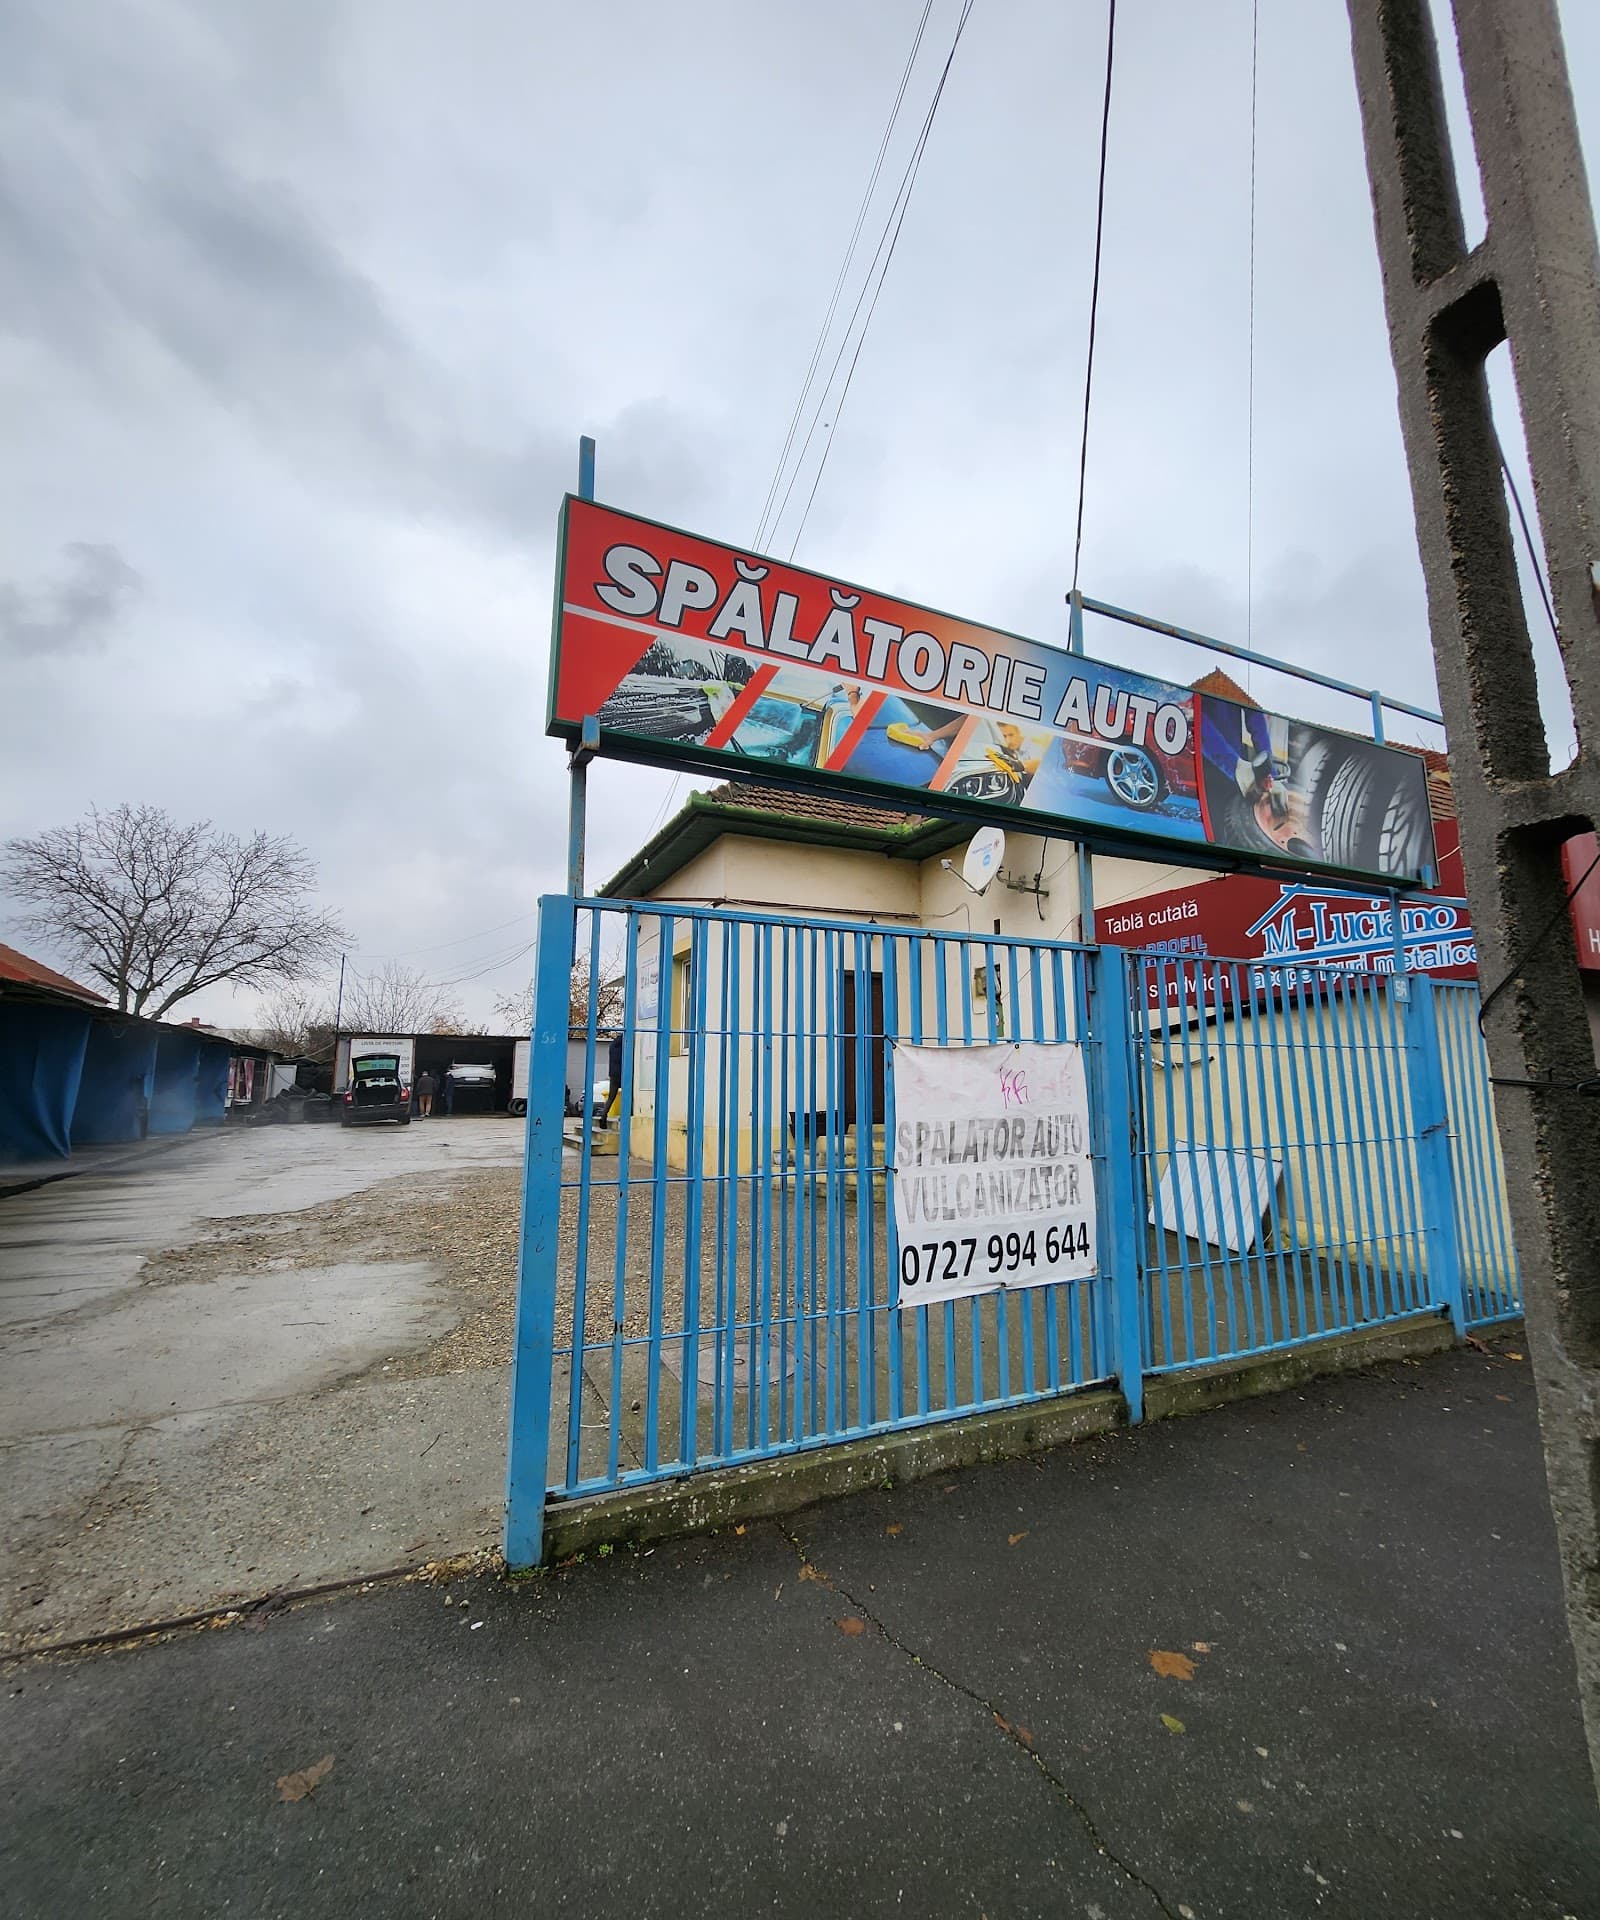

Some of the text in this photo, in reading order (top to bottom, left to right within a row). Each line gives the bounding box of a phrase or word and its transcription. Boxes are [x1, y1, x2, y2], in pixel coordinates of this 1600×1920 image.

[594, 544, 1188, 755] SPĂLĂTORIE AUTO
[1105, 899, 1199, 935] Tablă cutată
[898, 1113, 1083, 1167] SPALATOR AUTO
[902, 1163, 1082, 1225] VULCANIZATOR
[901, 1222, 1090, 1286] 0727 994 644
